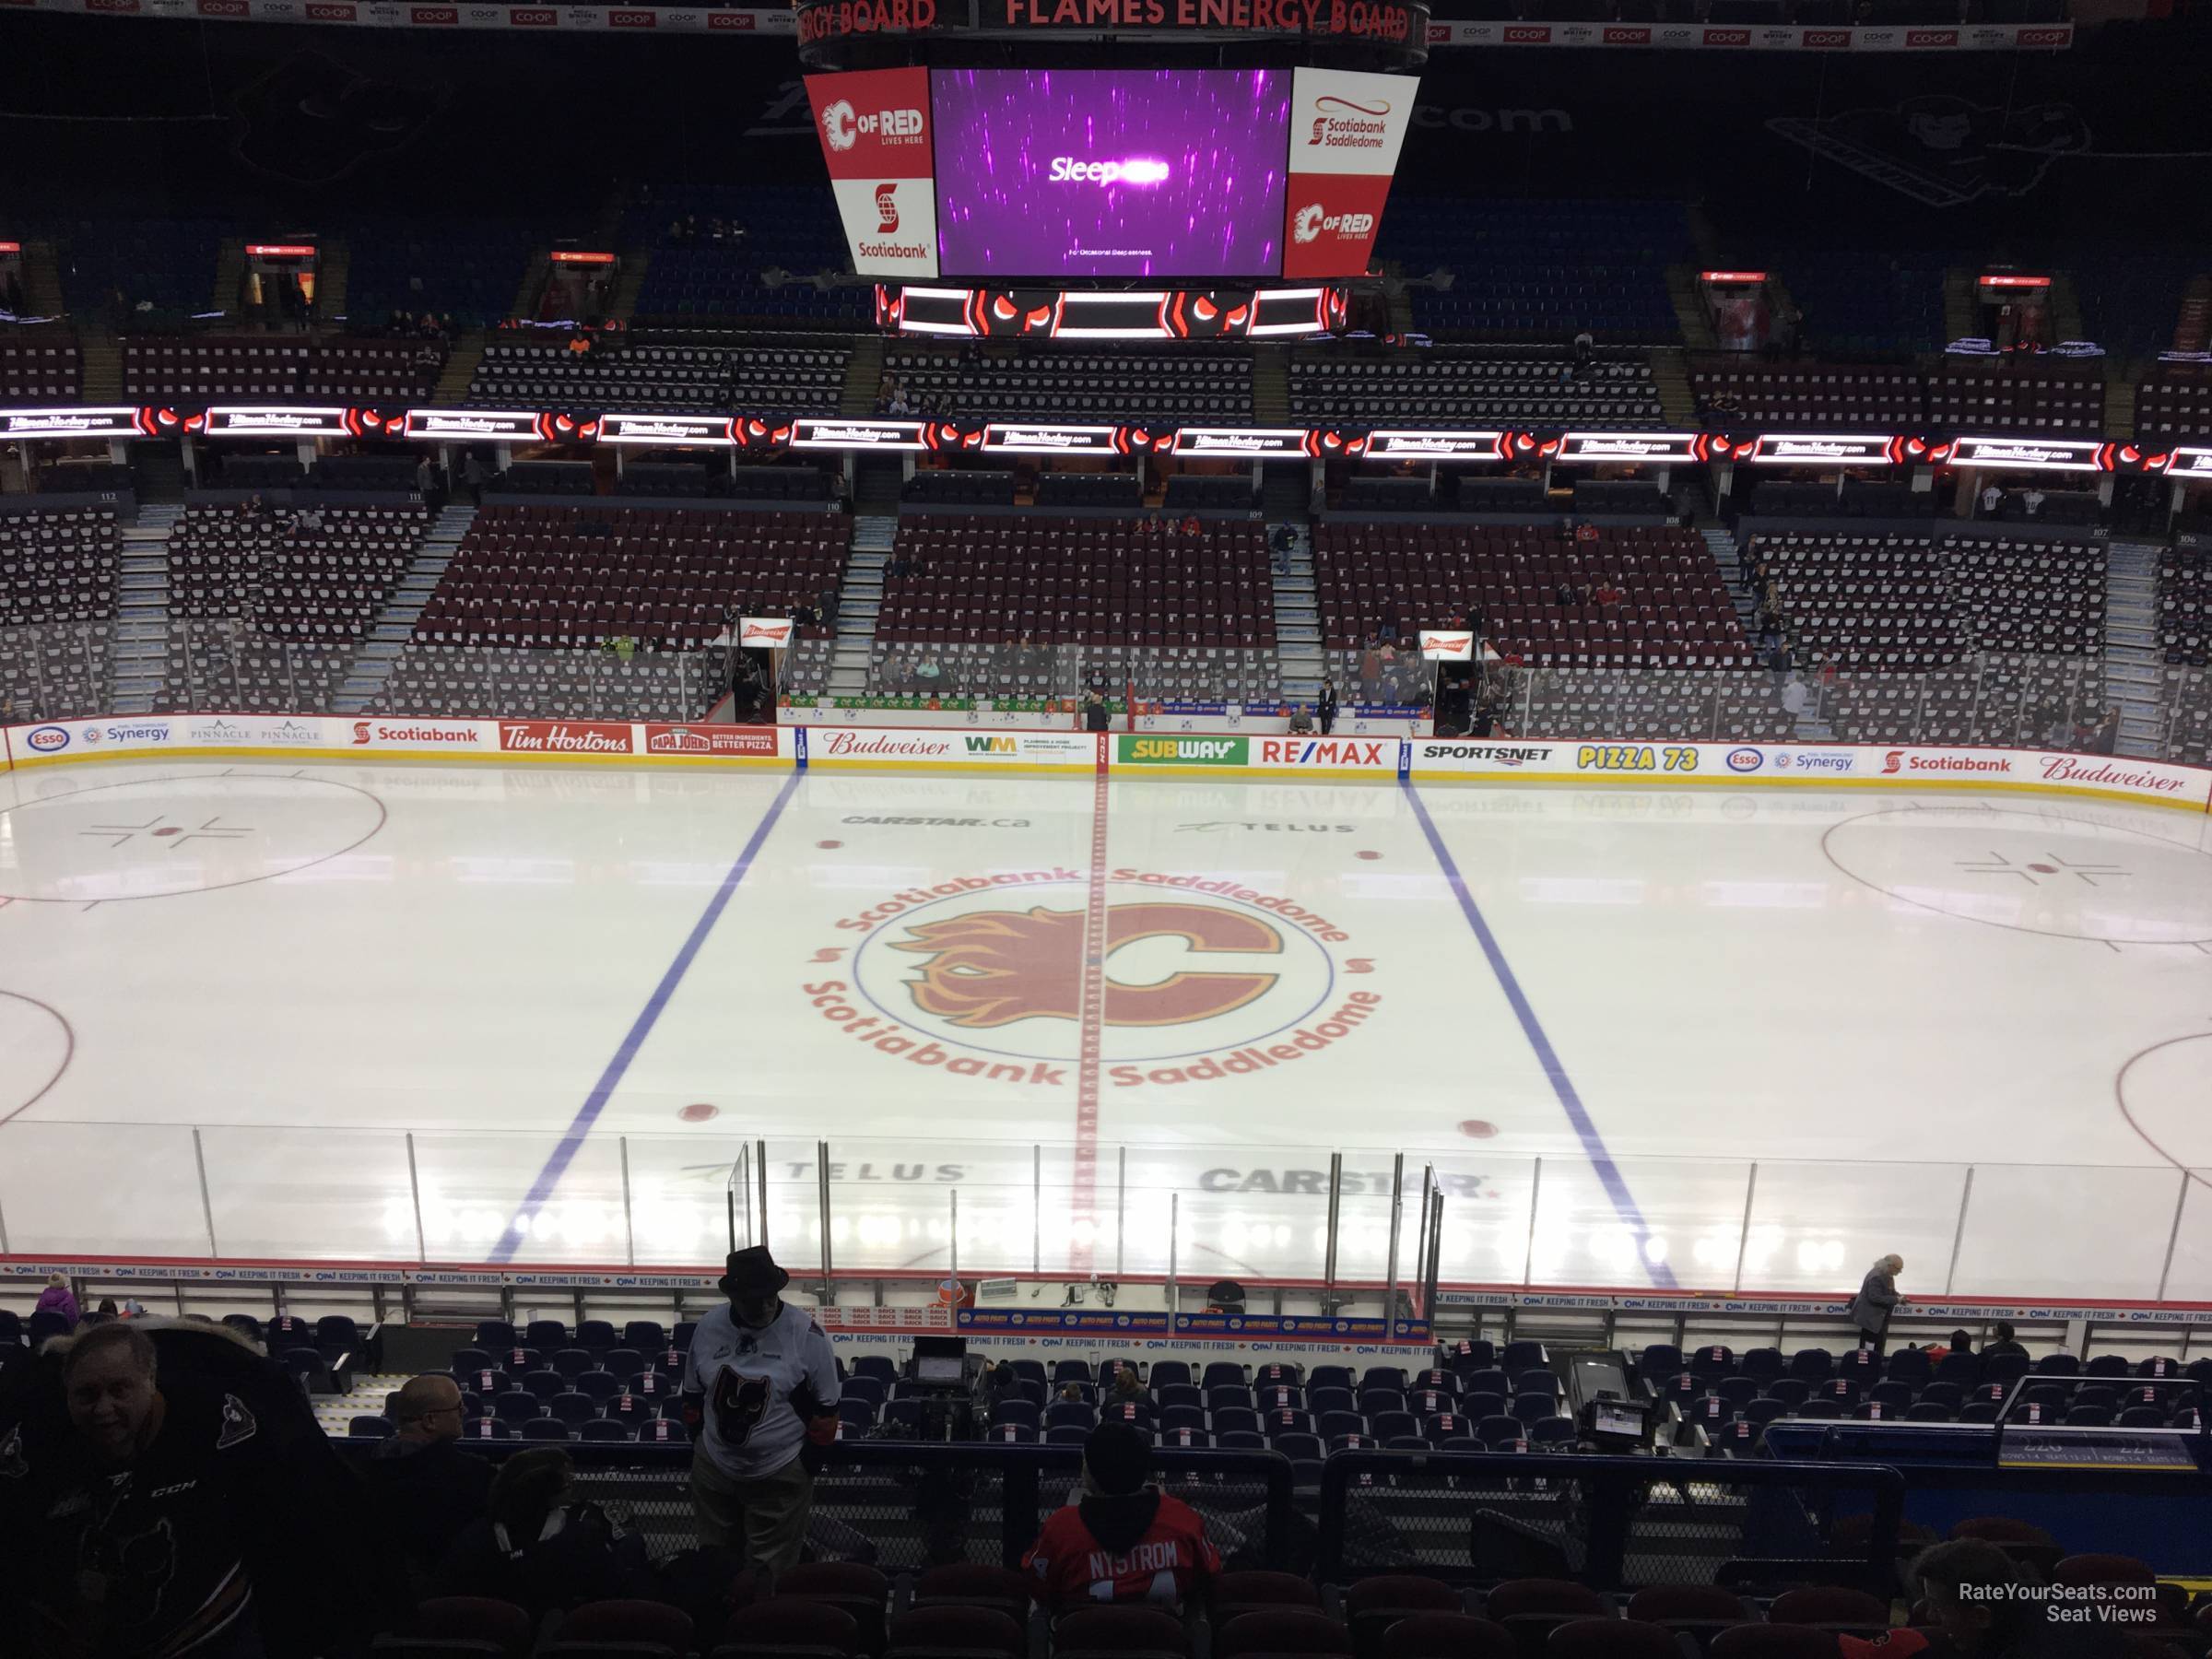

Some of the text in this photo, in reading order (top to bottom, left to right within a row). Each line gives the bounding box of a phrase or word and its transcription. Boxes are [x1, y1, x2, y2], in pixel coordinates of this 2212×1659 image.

[840, 0, 935, 34] BOARD
[1006, 0, 1409, 40] FLAMES ENERGY BOARD
[857, 114, 878, 134] OF
[880, 109, 924, 135] RED
[1327, 118, 1386, 134] Scotiabank
[881, 136, 924, 146] LIVES HERE
[1325, 134, 1383, 147] Saddledome
[1323, 216, 1341, 231] OF
[1339, 213, 1373, 233] RED
[859, 241, 927, 259] Scotiabank
[34, 733, 64, 745] Esso
[108, 726, 169, 742] Synergy
[190, 731, 251, 739] PINNACLE
[261, 731, 319, 740] PINNACLE
[378, 727, 478, 742] Scotiabank
[504, 725, 629, 752] Tim Hortons
[653, 735, 678, 748] PAPA
[823, 732, 951, 756] Budweiser
[965, 736, 1018, 752] WM
[1131, 740, 1236, 759] SUBWAY
[1262, 740, 1383, 765] RE/MAX
[1424, 745, 1553, 761] SPORTSNET
[1577, 745, 1699, 771] PIZZA 73
[1732, 755, 1759, 765] Esso
[1797, 755, 1853, 771] Synergy
[1909, 756, 2012, 772] Scotiabank
[2039, 756, 2185, 791] Budweiser
[1241, 823, 1356, 833] TELUS
[835, 867, 1081, 932] Scotiabank
[1110, 868, 1350, 943] Saddledome
[803, 980, 1068, 1086] Scotiabank
[1108, 990, 1382, 1087] Saddledome
[786, 1162, 966, 1182] TELUS
[1198, 1168, 1482, 1198] CARSTAR
[139, 1269, 167, 1277] KEEPING
[339, 1273, 369, 1282] KEEPING
[371, 1273, 377, 1282] IT
[378, 1273, 401, 1282] FRESH
[678, 1278, 701, 1287] FRESH
[1547, 1298, 1575, 1306] KEEPING
[1586, 1298, 1609, 1307] FRESH
[1951, 1308, 1980, 1317] KEEPING
[1982, 1309, 1989, 1317] IT
[1991, 1309, 2013, 1318] FRESH
[1276, 1343, 1306, 1351] KEEPING
[1317, 1344, 1340, 1352] FRESH
[151, 1479, 197, 1497] CCM
[1089, 1540, 1178, 1579] NYSTROM
